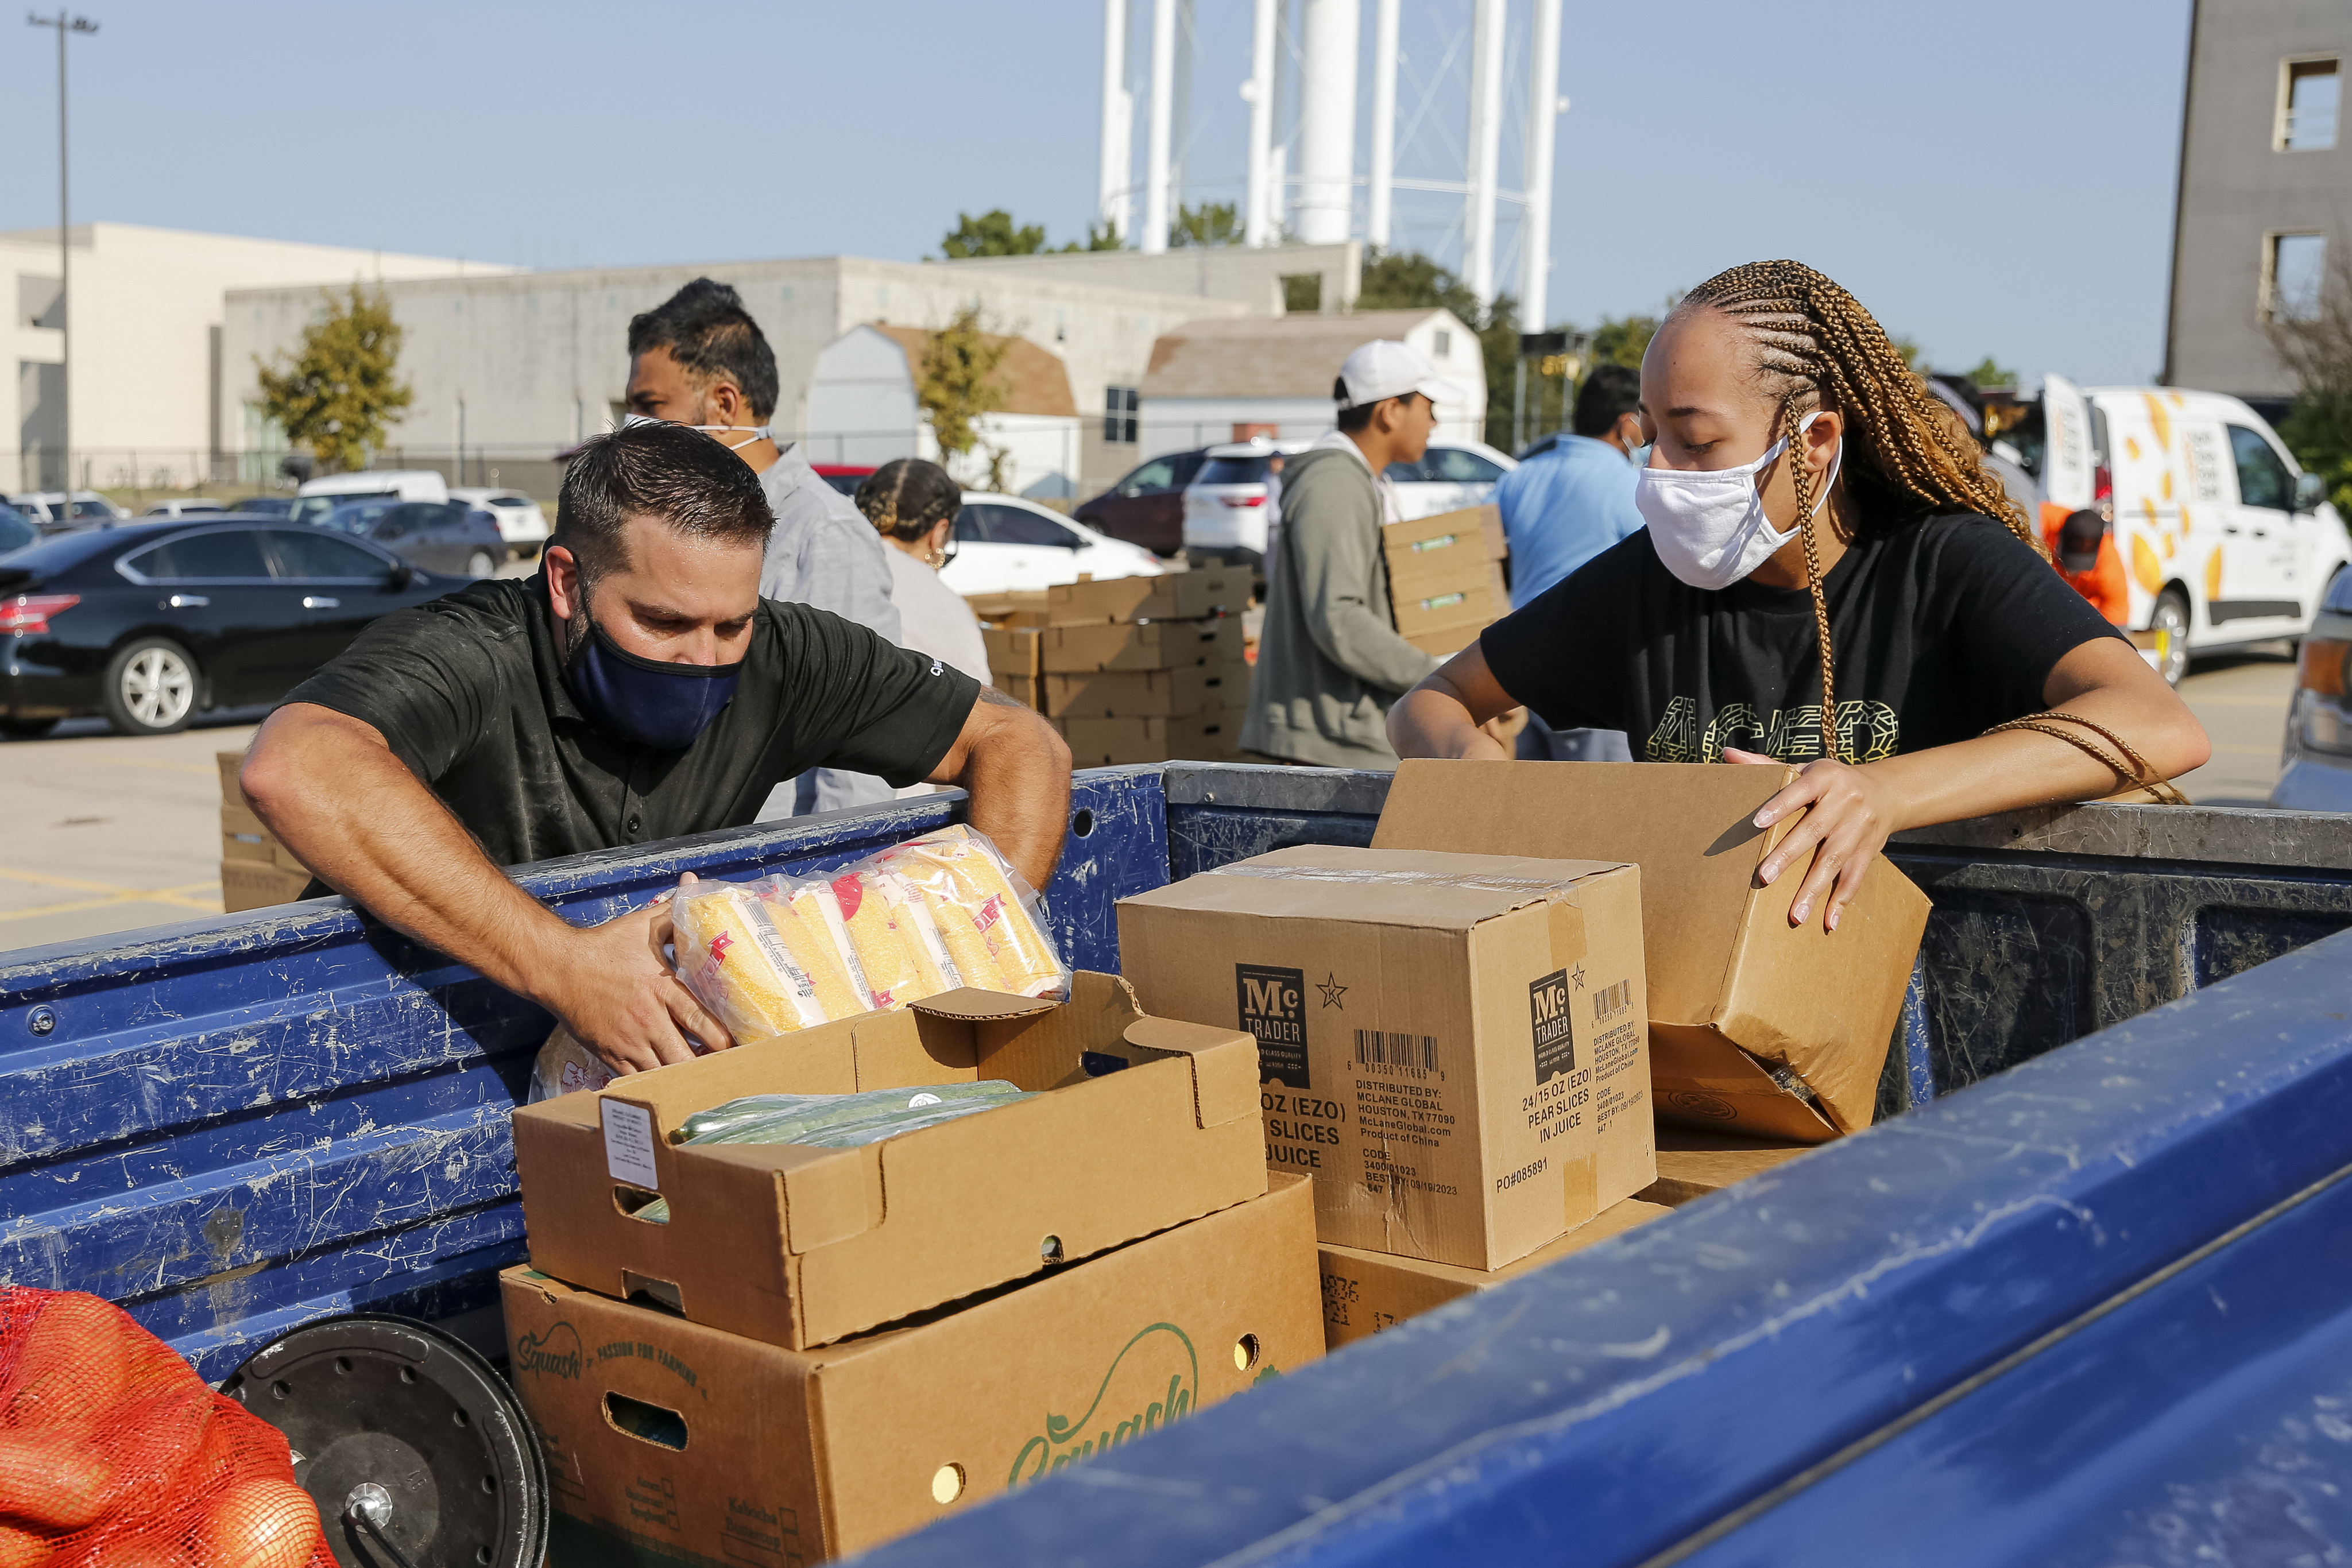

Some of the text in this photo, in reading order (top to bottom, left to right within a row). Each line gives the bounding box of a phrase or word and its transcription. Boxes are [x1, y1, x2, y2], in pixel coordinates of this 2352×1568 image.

[797, 988, 816, 998] rits
[1245, 1018, 1301, 1042] TRADER
[1535, 1016, 1569, 1044] TRADER
[1593, 1020, 1635, 1047] DISTRIBUTED BY:
[1594, 1029, 1636, 1056] MCLANE GLOBAL
[1595, 1047, 1621, 1065] HOUSTON,
[1621, 1043, 1628, 1052] TX
[1266, 1050, 1281, 1058] CLASS
[1281, 1051, 1301, 1060] QUALITY
[1595, 1047, 1639, 1075] McLaneGlobal.com
[1347, 1060, 1445, 1082] 6 00350 11685 9
[1596, 1059, 1634, 1084] Product of China
[1356, 1079, 1442, 1099] DISTRIBUTED BY:
[1522, 1067, 1592, 1112] 24/15 OZ (EZO)
[1596, 1086, 1611, 1101] CODE
[1261, 1093, 1346, 1122] OZ (EZO)
[1357, 1092, 1443, 1111] MCLANE GLOBAL
[1528, 1088, 1589, 1129] PEAR SLICES
[1597, 1091, 1624, 1112] 3400/01023
[1358, 1104, 1456, 1125] HOUSTON, TX 77090
[1359, 1116, 1451, 1137] McLaneGlobal.com
[1597, 1109, 1611, 1124] BEST
[1611, 1105, 1620, 1116] BY:
[1270, 1119, 1340, 1145] SLICES
[1360, 1128, 1440, 1147] Product of China
[1540, 1112, 1581, 1144] IN JUICE
[1266, 1143, 1322, 1168] JUICE
[1363, 1148, 1391, 1161] CODE
[1364, 1160, 1417, 1176] 3400/01023
[1496, 1156, 1549, 1194] PO#085891
[1365, 1171, 1390, 1183] BEST
[1410, 1179, 1457, 1195] 09/19/2023
[518, 1321, 582, 1380] Squash
[597, 1341, 698, 1388] PASSION FOR FARMING
[728, 1496, 778, 1526] Kabocha
